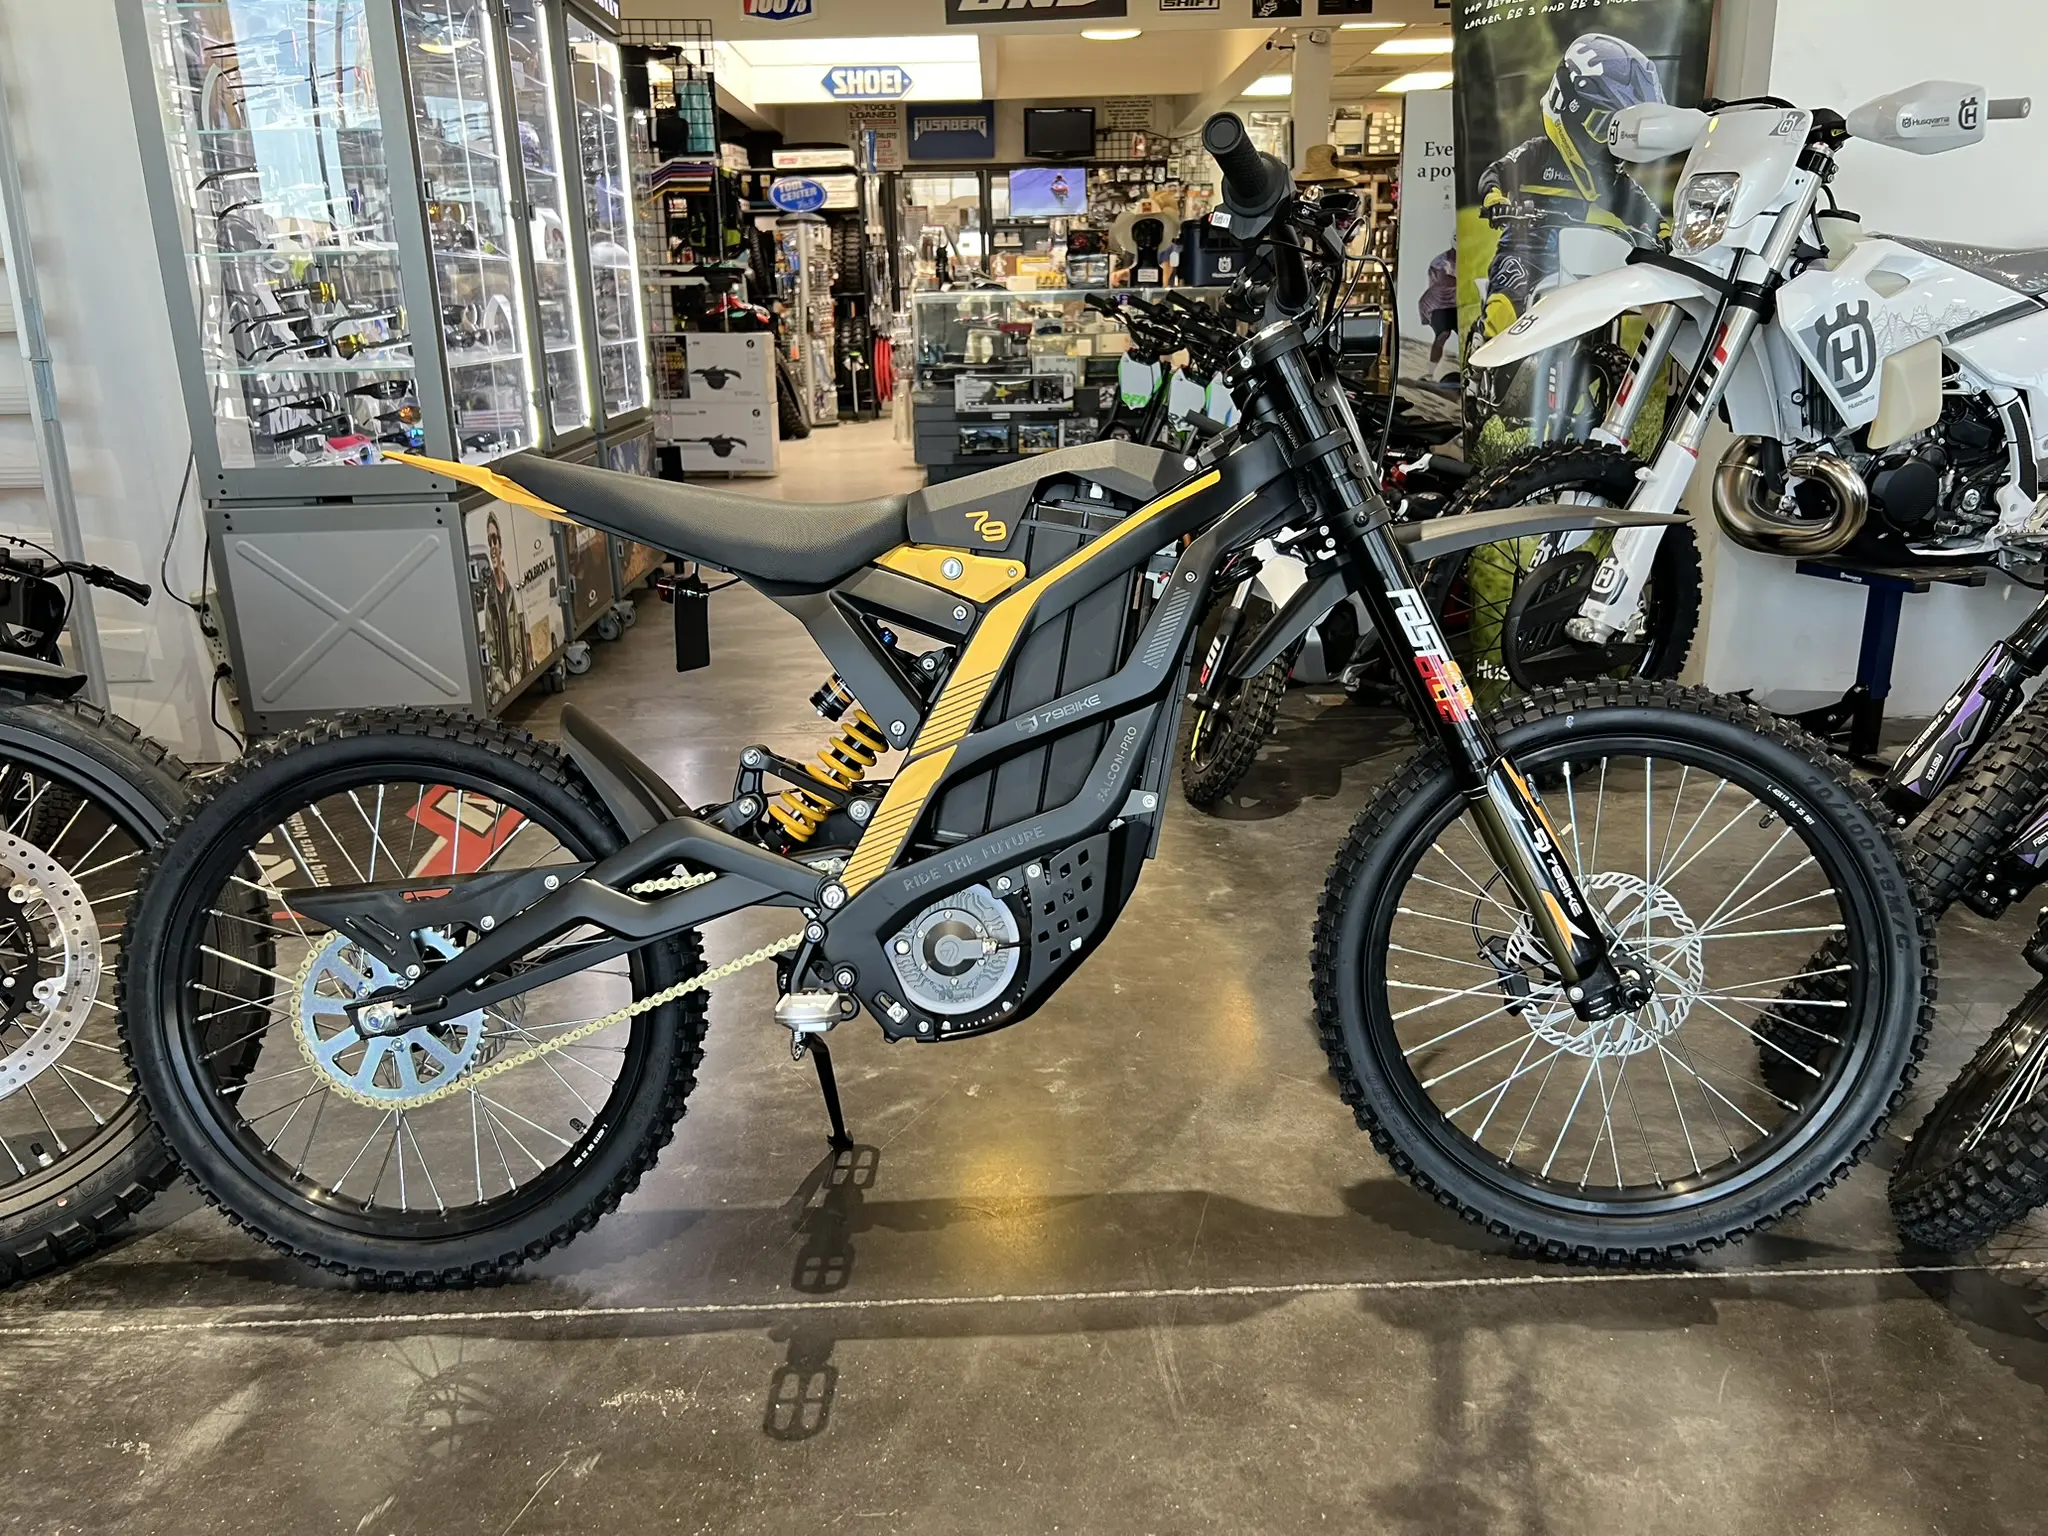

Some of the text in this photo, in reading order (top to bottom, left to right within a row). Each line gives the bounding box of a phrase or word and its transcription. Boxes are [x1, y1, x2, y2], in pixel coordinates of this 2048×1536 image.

[1464, 2, 1482, 15] GAP
[1464, 13, 1502, 30] LARGER
[1506, 7, 1524, 20] EE
[1528, 6, 1536, 16] 3
[1541, 2, 1566, 14] AND
[831, 69, 902, 95] SHOEI
[849, 111, 897, 119] LOANED
[913, 116, 988, 142] HUSABERG
[1424, 140, 1454, 158] Eve
[780, 180, 804, 193] TOOL
[1417, 165, 1455, 183] a po
[780, 187, 818, 203] CENTER
[965, 510, 1007, 542] 79
[1040, 694, 1102, 723] 79BIKE
[1905, 713, 1946, 758] 79BIKE
[1097, 726, 1138, 803] FALCON-PRO
[1788, 800, 1798, 809] 04
[1796, 807, 1806, 816] 25
[1803, 814, 1815, 825] DOT
[299, 839, 321, 863] Fears
[903, 825, 1046, 892] RIDE THE FUTURE
[1546, 852, 1584, 918] 79BIKE
